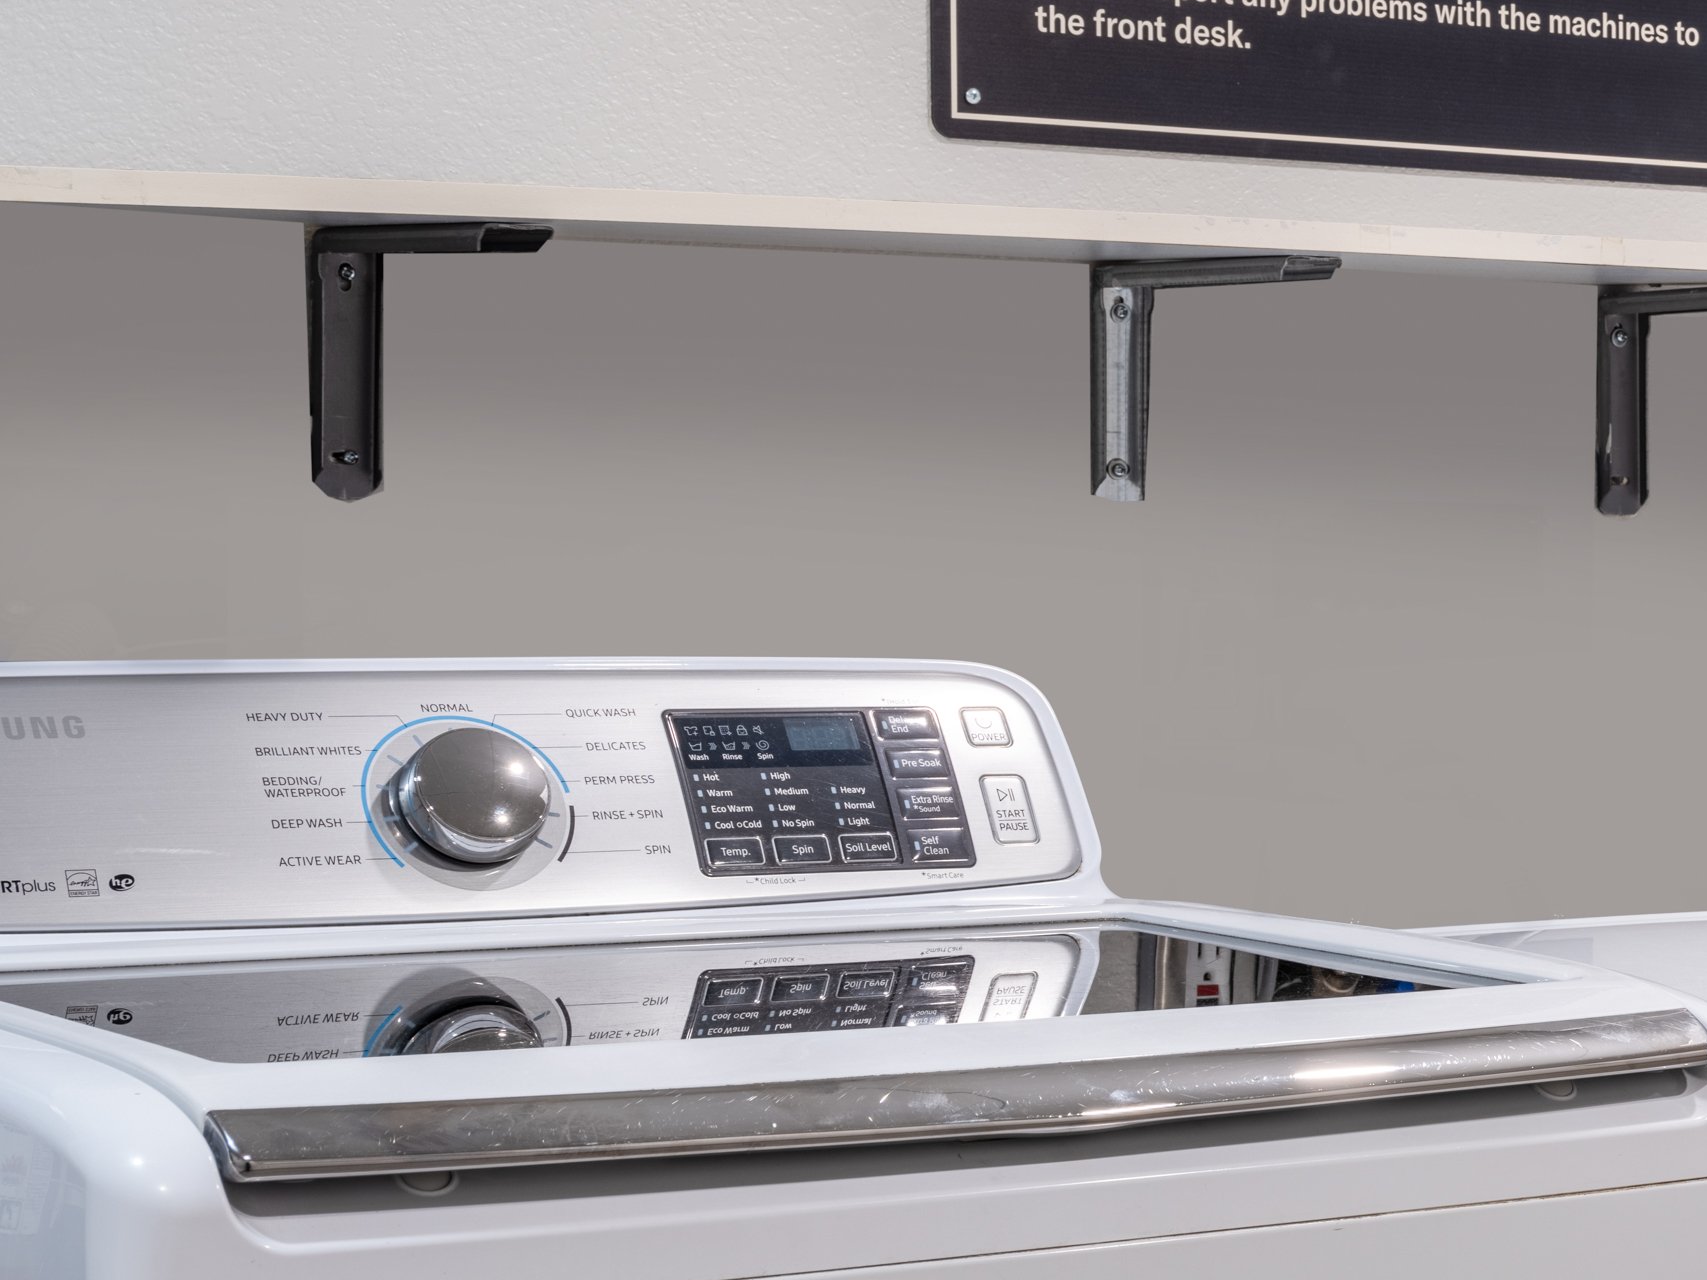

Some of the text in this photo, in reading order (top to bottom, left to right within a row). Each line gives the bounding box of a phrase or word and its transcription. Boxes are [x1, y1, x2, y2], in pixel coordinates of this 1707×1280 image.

[1035, 5, 1250, 49] the front desk.
[1435, 0, 1490, 27] with
[1498, 4, 1540, 32] the
[1550, 12, 1668, 43] machines
[1675, 22, 1699, 46] to
[421, 704, 473, 713] NORMAL
[565, 708, 636, 718] QUICK WASH
[246, 712, 323, 722] HEAVY DUTY
[971, 733, 1006, 741] POWER
[586, 741, 647, 751] DELICATES
[255, 746, 362, 757] BRILLIANT WHITES
[902, 758, 941, 767] Pre Soak
[262, 776, 323, 786] BEDDING/
[585, 775, 655, 785] PERM PRESS
[770, 772, 791, 781] High
[264, 788, 346, 798] WATERPROOF
[707, 789, 733, 797] Warm
[774, 787, 809, 796] Medium
[840, 786, 866, 795] Heavy
[911, 795, 953, 804] Extra Rinse
[711, 805, 753, 813] Eco Warm
[778, 804, 796, 812] Low
[844, 801, 875, 810] Normal
[592, 811, 626, 820] RINSE
[638, 810, 663, 819] SPIN
[996, 809, 1025, 818] START
[271, 818, 343, 829] DEEP WASH
[714, 821, 734, 829] Cool
[796, 819, 815, 828] Spin
[848, 817, 870, 826] Light
[1000, 822, 1029, 831] PAUSE
[922, 837, 940, 845] Self
[645, 845, 671, 854] SPIN
[721, 847, 751, 857] Temp.
[792, 845, 814, 856] Spin
[845, 843, 891, 852] Soil Level
[924, 846, 950, 855] Clean
[279, 855, 362, 867] ACTIVE WEAR
